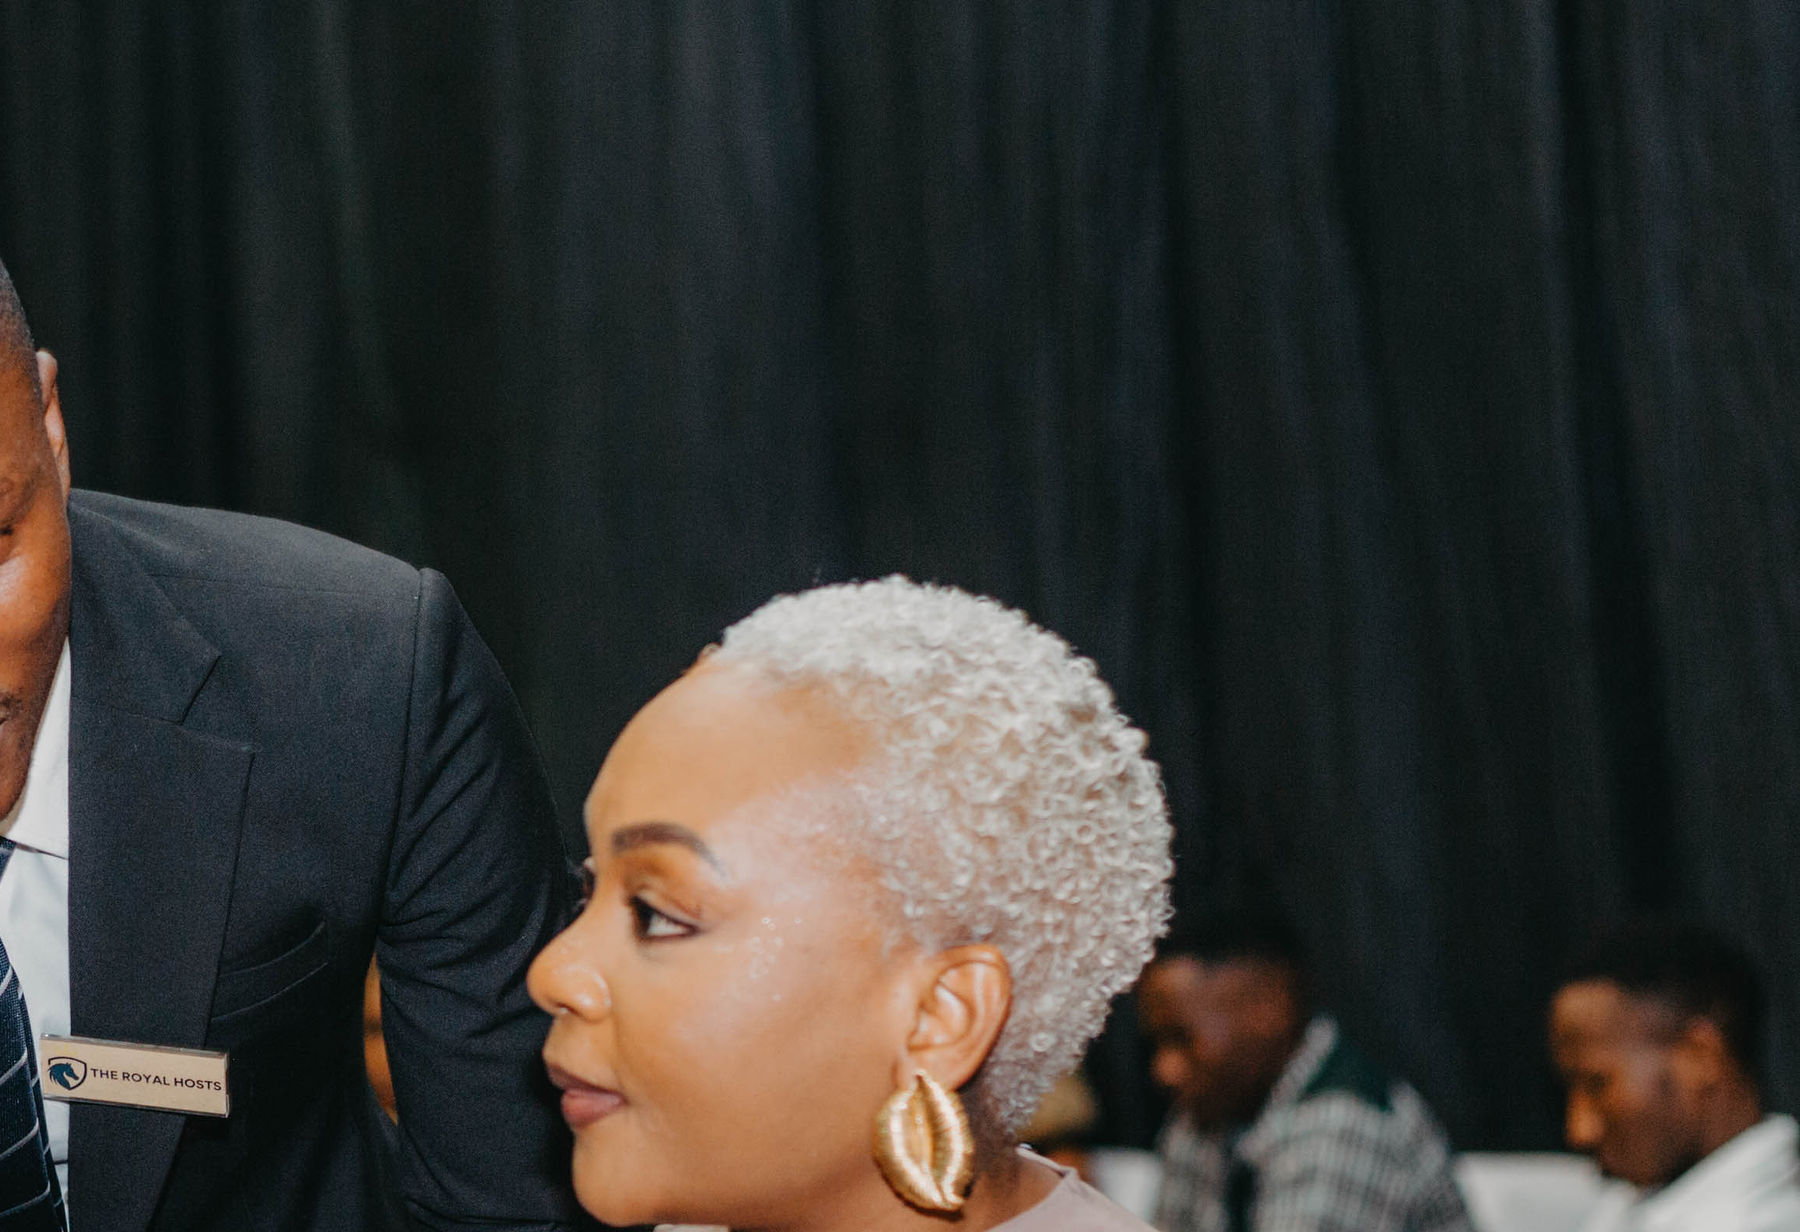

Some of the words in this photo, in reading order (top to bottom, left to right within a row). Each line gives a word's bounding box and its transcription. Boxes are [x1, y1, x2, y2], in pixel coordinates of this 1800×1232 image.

[90, 1068, 119, 1080] THE
[122, 1071, 170, 1086] ROYAL
[174, 1077, 222, 1091] HOSTS
